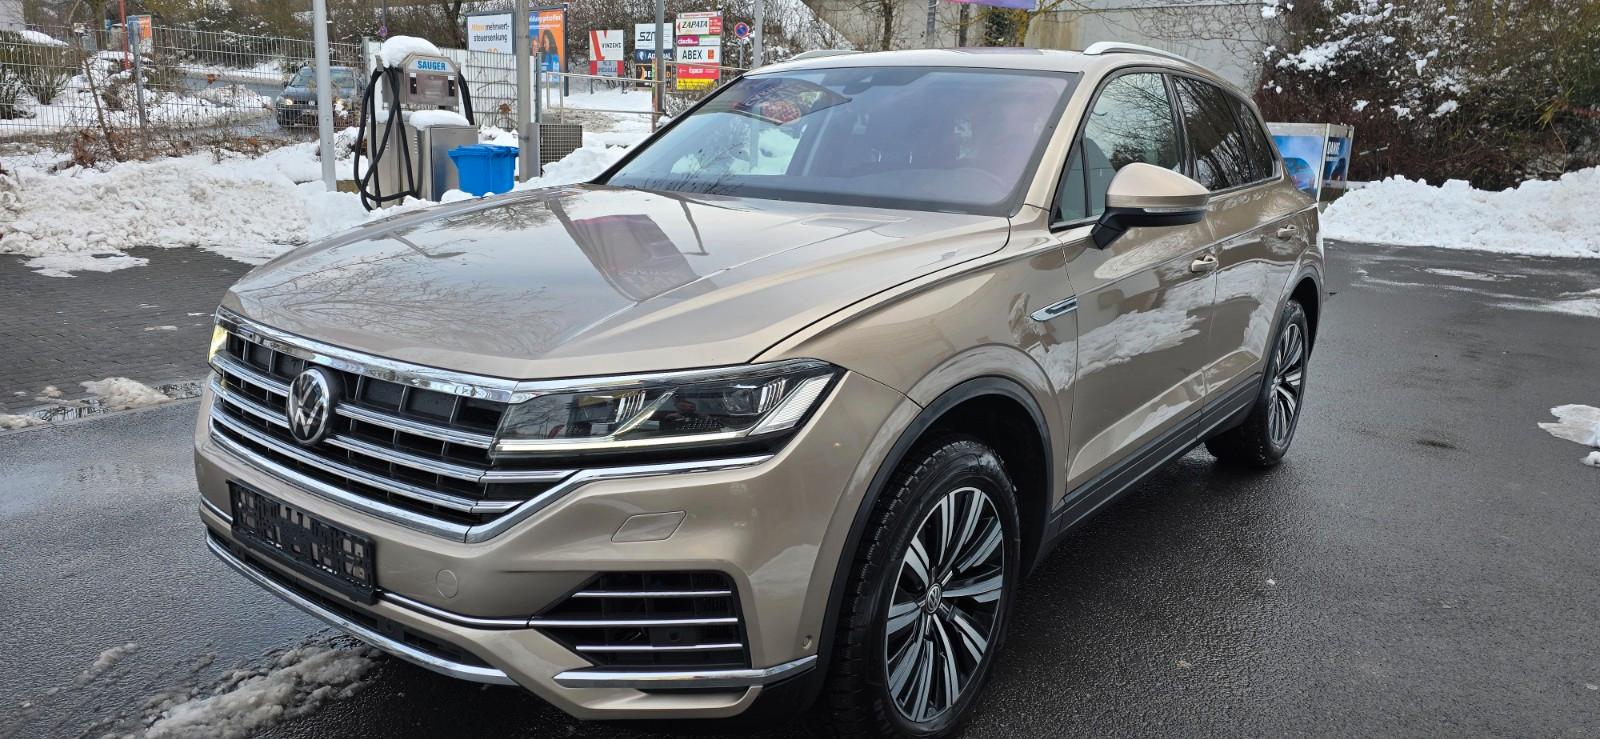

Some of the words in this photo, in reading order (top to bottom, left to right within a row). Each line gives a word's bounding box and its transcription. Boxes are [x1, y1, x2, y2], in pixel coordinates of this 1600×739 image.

[681, 20, 708, 29] ZAPATA
[682, 50, 703, 60] ABEX
[417, 60, 446, 71] SAUGER
